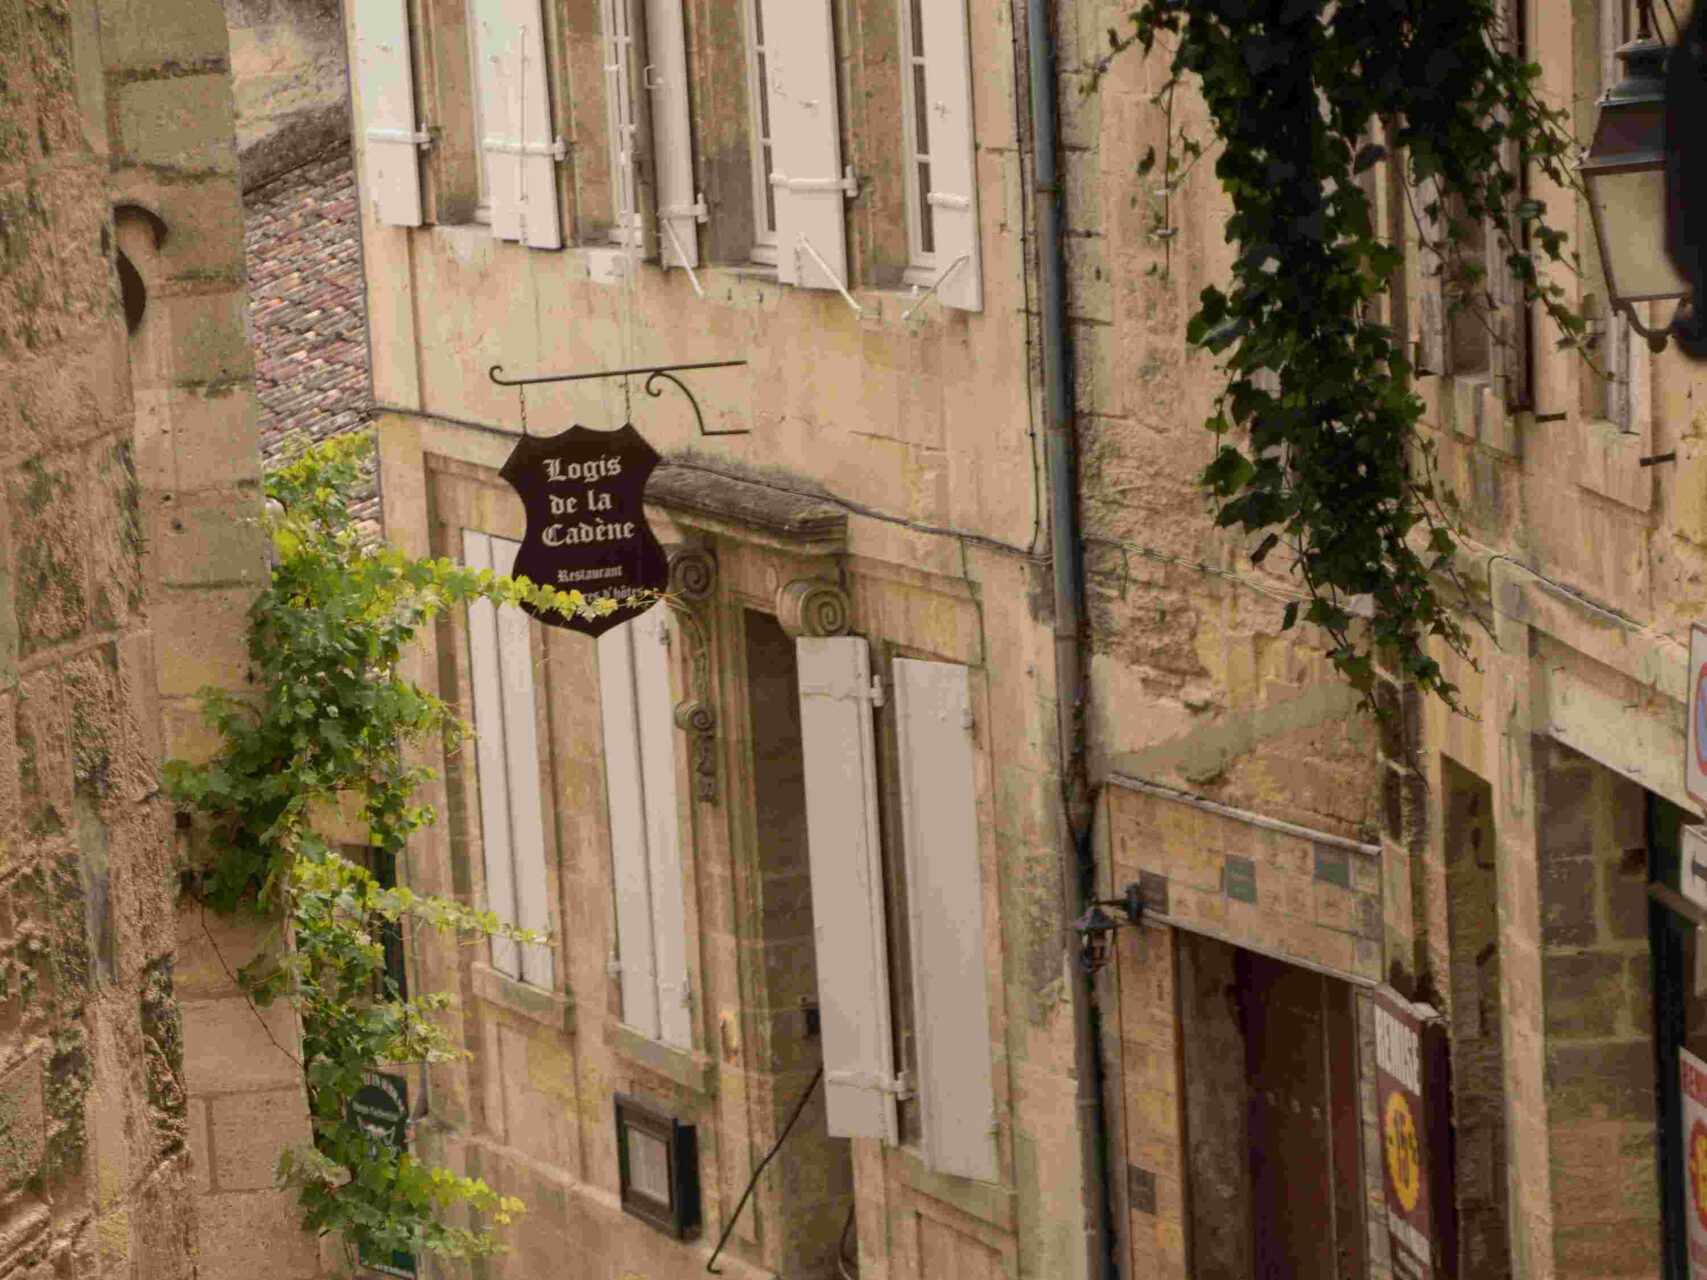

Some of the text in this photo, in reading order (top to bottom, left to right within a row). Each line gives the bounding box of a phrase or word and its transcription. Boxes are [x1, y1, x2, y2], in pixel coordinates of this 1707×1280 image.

[542, 454, 622, 482] Logis
[549, 489, 612, 515] de la
[541, 517, 635, 546] Cadène
[557, 565, 622, 582] Restaurant
